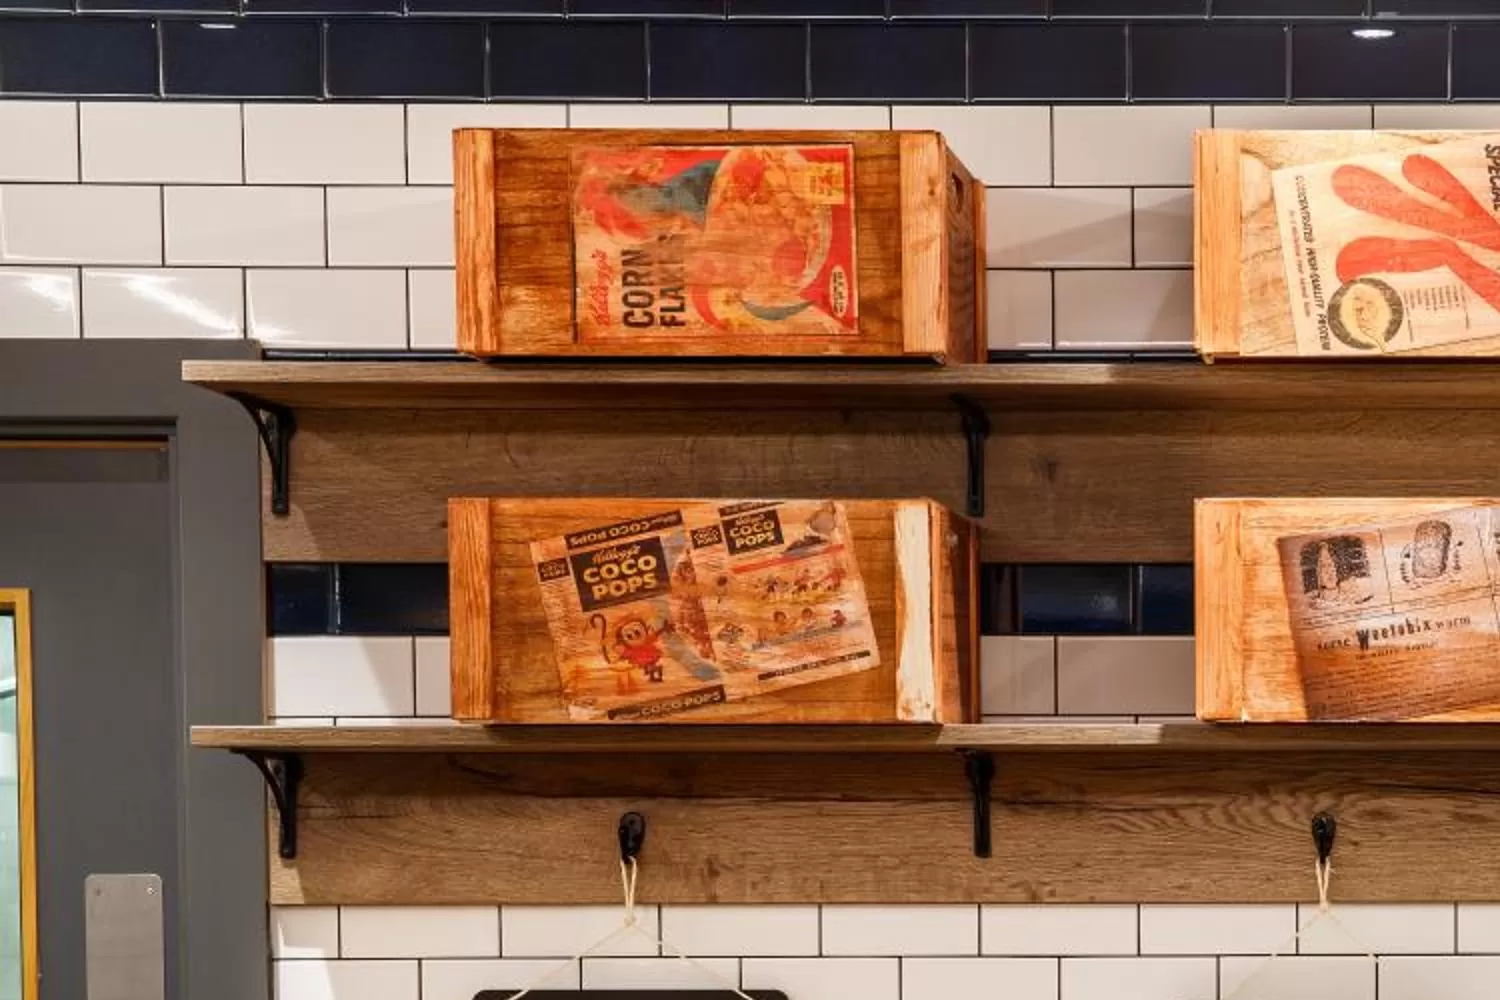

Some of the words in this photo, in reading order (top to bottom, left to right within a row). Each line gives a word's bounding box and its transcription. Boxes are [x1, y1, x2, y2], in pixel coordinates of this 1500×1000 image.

[621, 249, 656, 328] CORN
[729, 521, 775, 538] COCO
[735, 530, 775, 549] POPS
[583, 555, 658, 584] COCO
[591, 572, 658, 600] POPS
[1355, 617, 1432, 651] Weetabix
